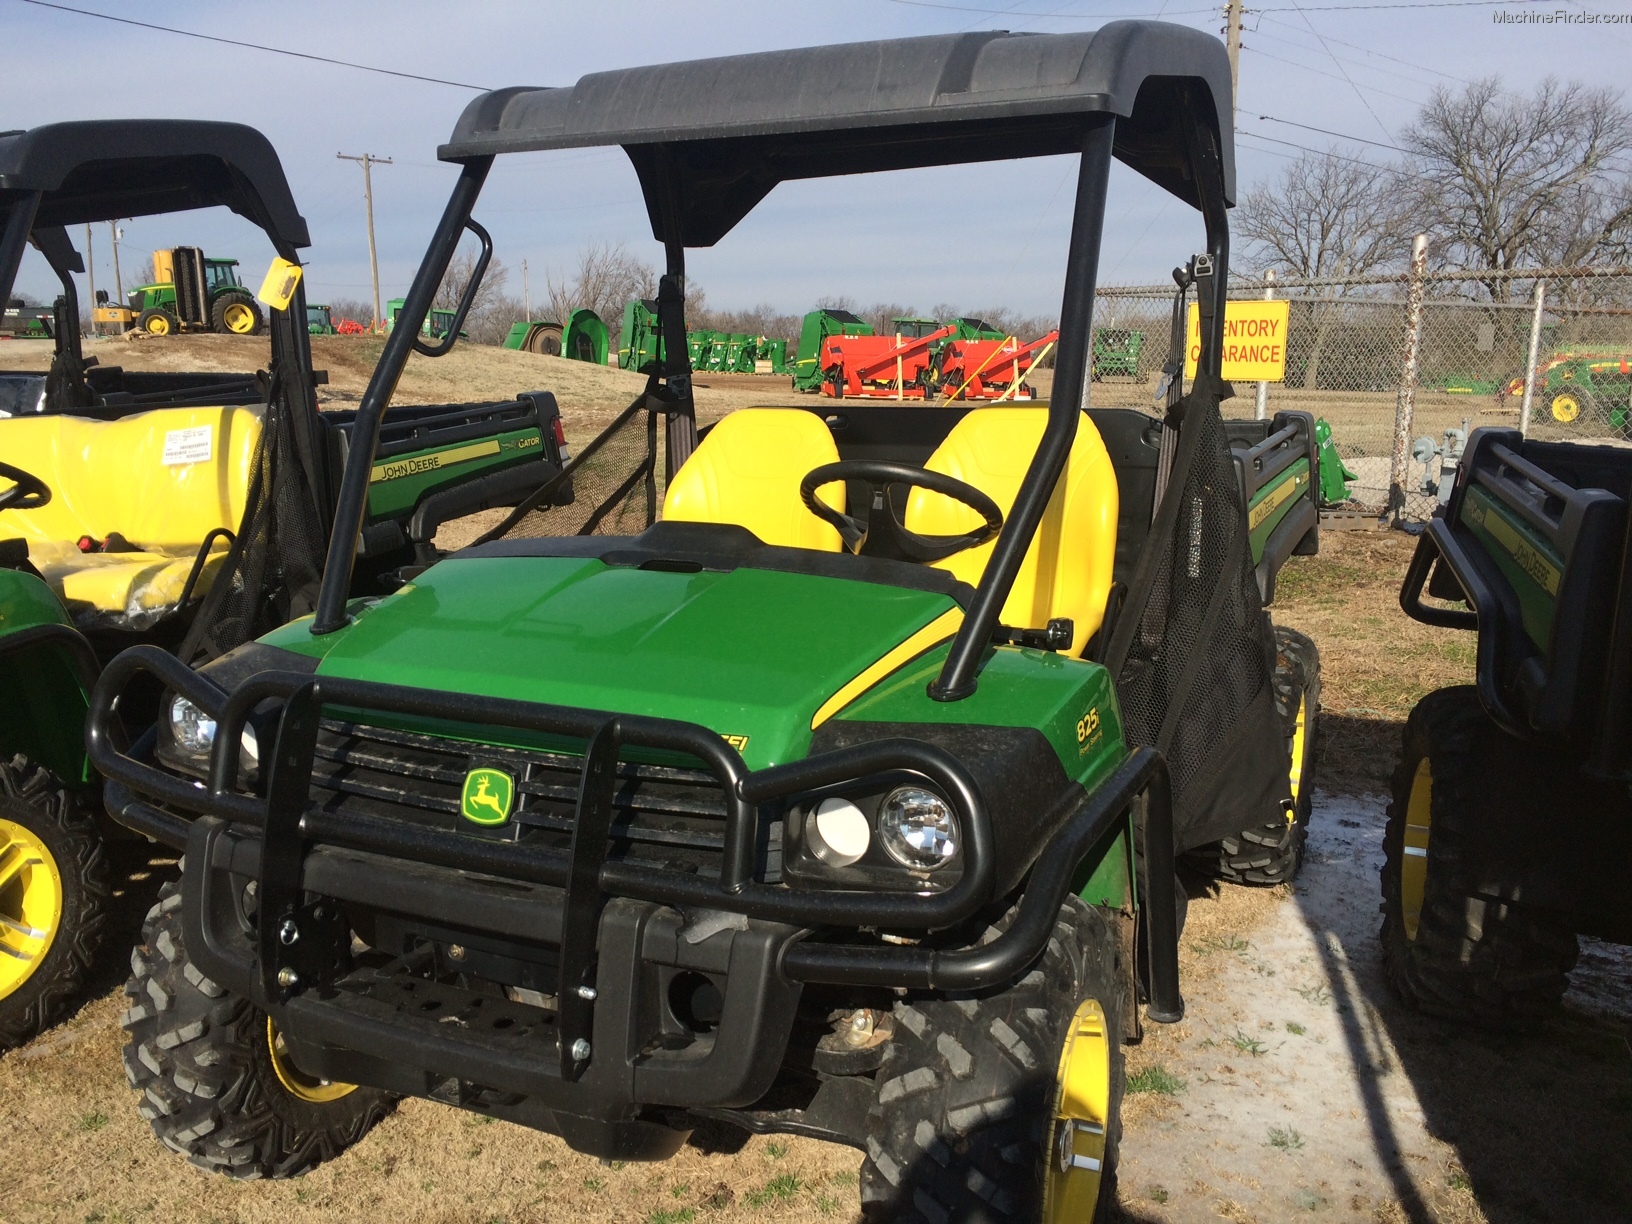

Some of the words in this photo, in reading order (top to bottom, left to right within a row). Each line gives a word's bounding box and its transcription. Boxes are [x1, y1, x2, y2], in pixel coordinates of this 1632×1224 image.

[1191, 345, 1280, 363] CARANCE
[518, 437, 540, 449] GATOR
[382, 462, 409, 480] JOHN
[408, 457, 440, 475] DEERE
